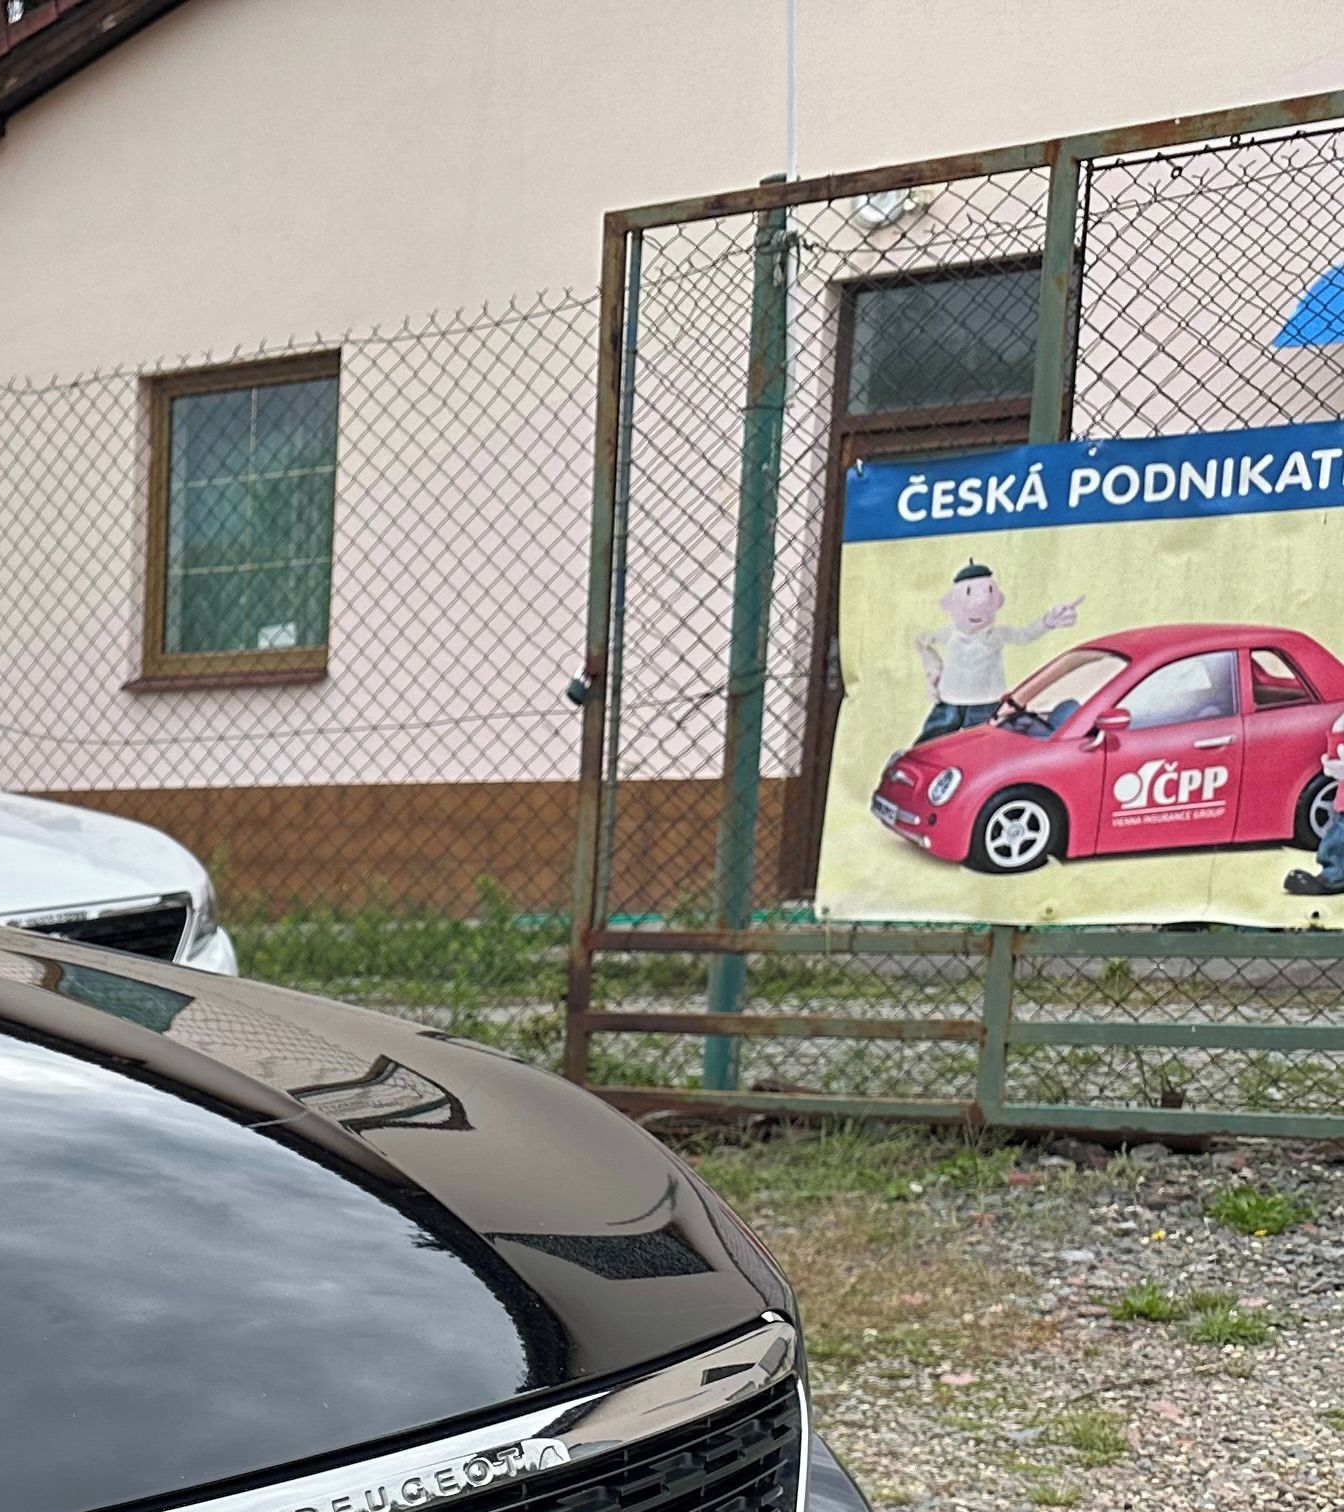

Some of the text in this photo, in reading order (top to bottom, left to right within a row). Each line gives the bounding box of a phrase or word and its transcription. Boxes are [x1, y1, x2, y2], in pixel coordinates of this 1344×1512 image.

[897, 447, 1344, 523] ČESKÁ PODNIKAT
[1153, 760, 1229, 805] ČPP
